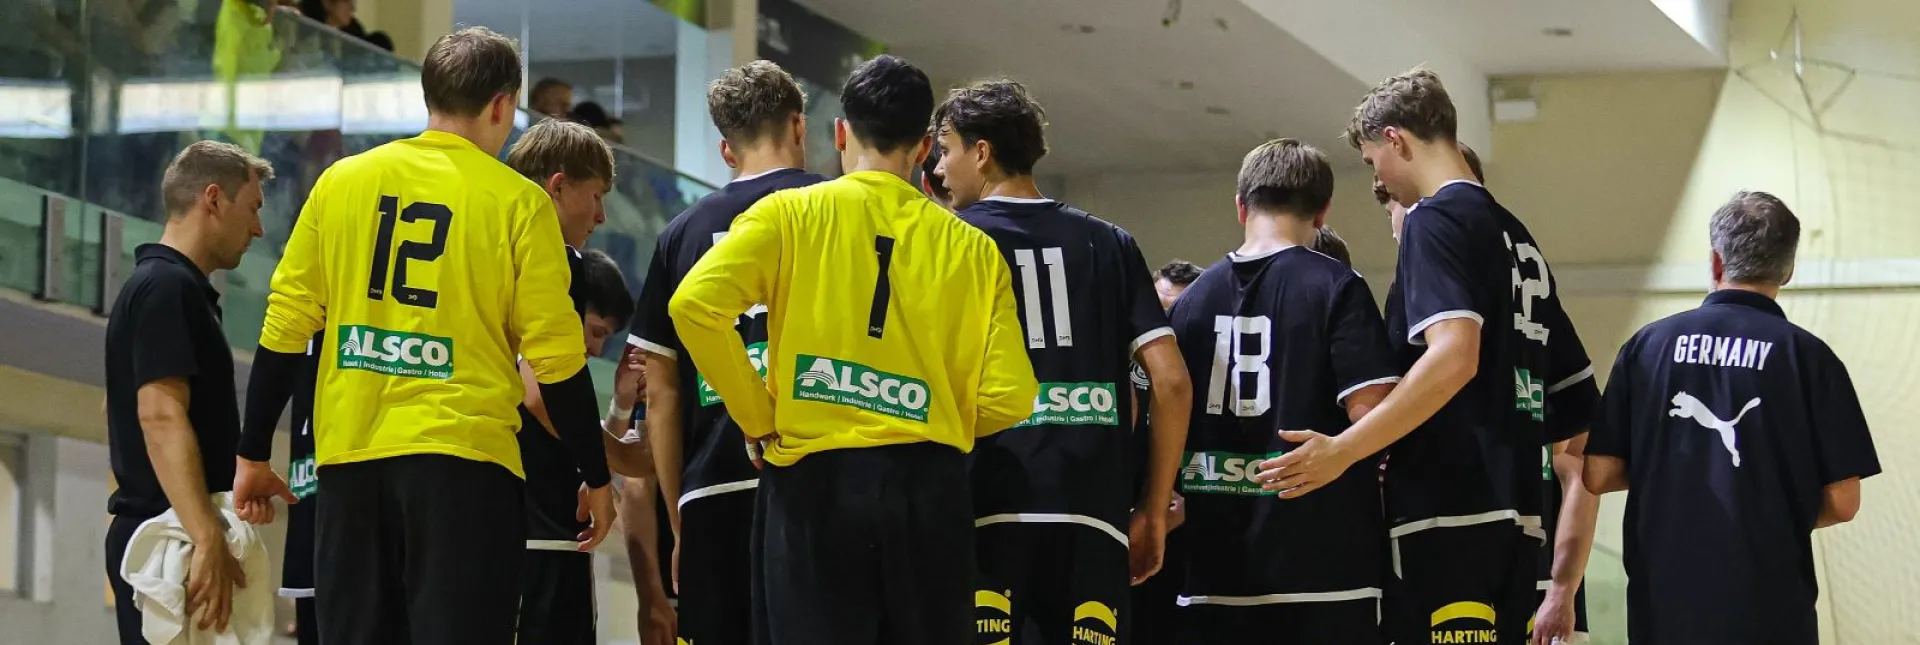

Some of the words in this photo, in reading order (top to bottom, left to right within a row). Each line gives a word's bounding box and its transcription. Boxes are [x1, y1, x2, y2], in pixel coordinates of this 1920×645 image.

[367, 194, 453, 309] 12
[867, 234, 895, 339] 1
[1014, 247, 1073, 349] 11
[340, 326, 449, 367] ALSCO
[1673, 334, 1773, 371] GERMANY
[397, 367, 422, 375] Gastro
[1206, 315, 1271, 416] 18
[796, 357, 927, 410] ALSCO
[799, 390, 836, 401] Handwerk
[1033, 386, 1113, 413] LSCO
[1182, 452, 1266, 483] ALSC
[976, 618, 1011, 633] TING
[1072, 626, 1116, 645] HARTING
[1431, 629, 1497, 644] HARTING
